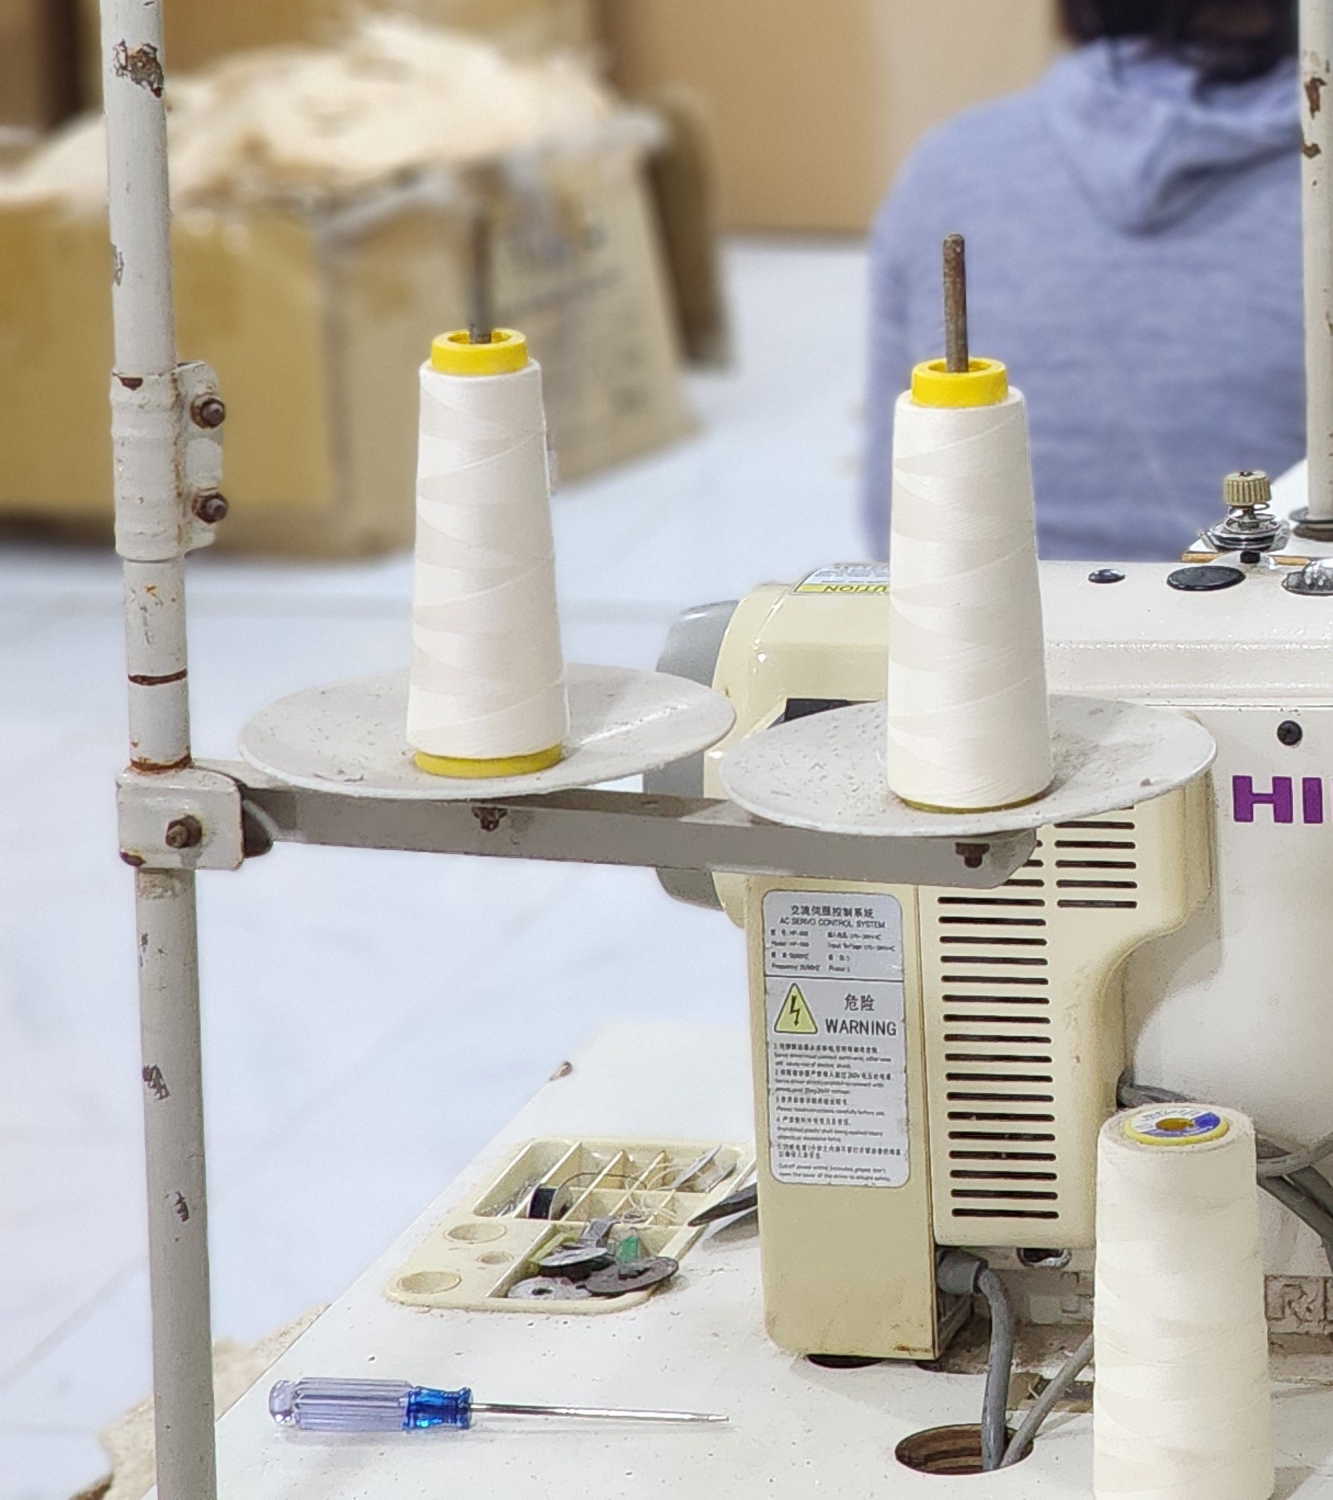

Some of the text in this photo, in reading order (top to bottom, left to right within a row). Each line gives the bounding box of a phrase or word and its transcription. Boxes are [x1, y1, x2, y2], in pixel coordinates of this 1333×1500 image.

[823, 583, 889, 593] UTION
[779, 917, 886, 929] AC SERVO CONTROL SYSTEM
[843, 993, 875, 1012] 危险
[825, 1018, 897, 1037] WARNING
